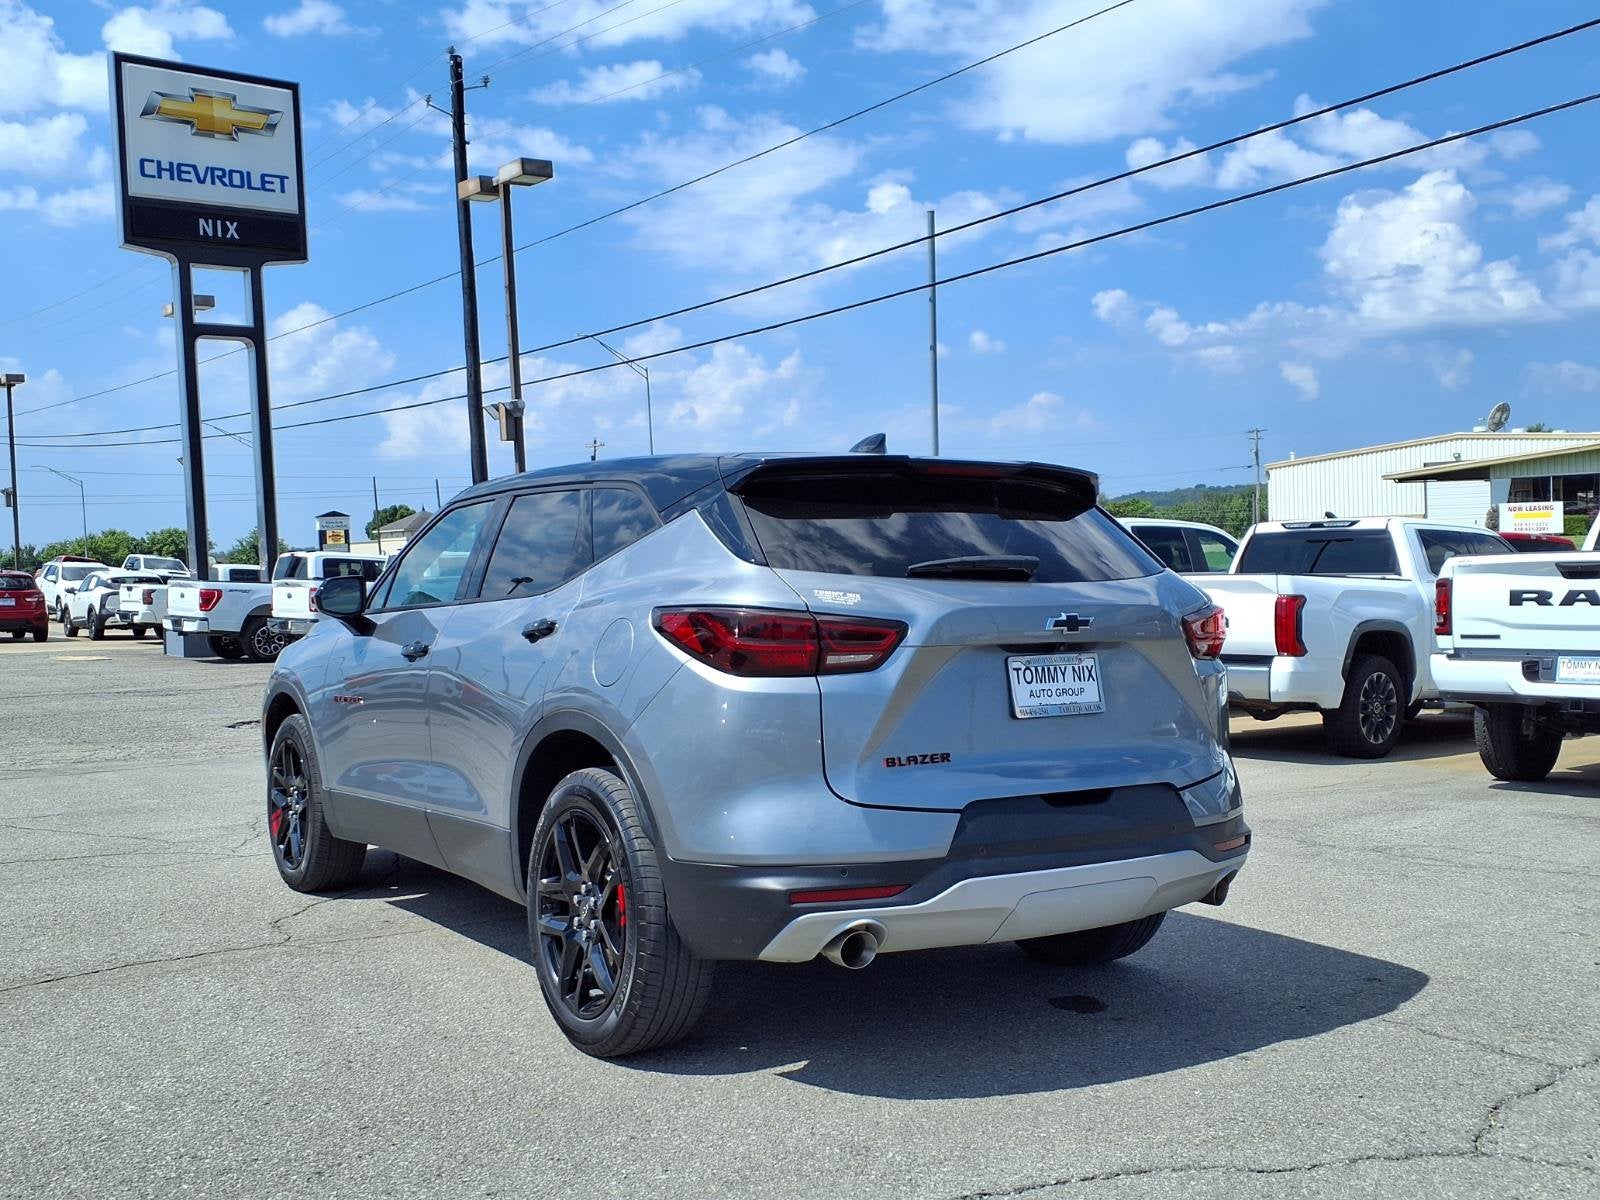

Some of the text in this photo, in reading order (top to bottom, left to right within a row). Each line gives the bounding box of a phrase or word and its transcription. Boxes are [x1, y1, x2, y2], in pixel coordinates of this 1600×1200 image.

[139, 158, 289, 194] CHEVROLET
[198, 218, 240, 240] NIX
[1013, 664, 1096, 684] TOMMY NIX
[1561, 660, 1592, 670] TOMMY
[1029, 687, 1085, 698] AUTO GROUP
[883, 752, 952, 768] BLAZER
